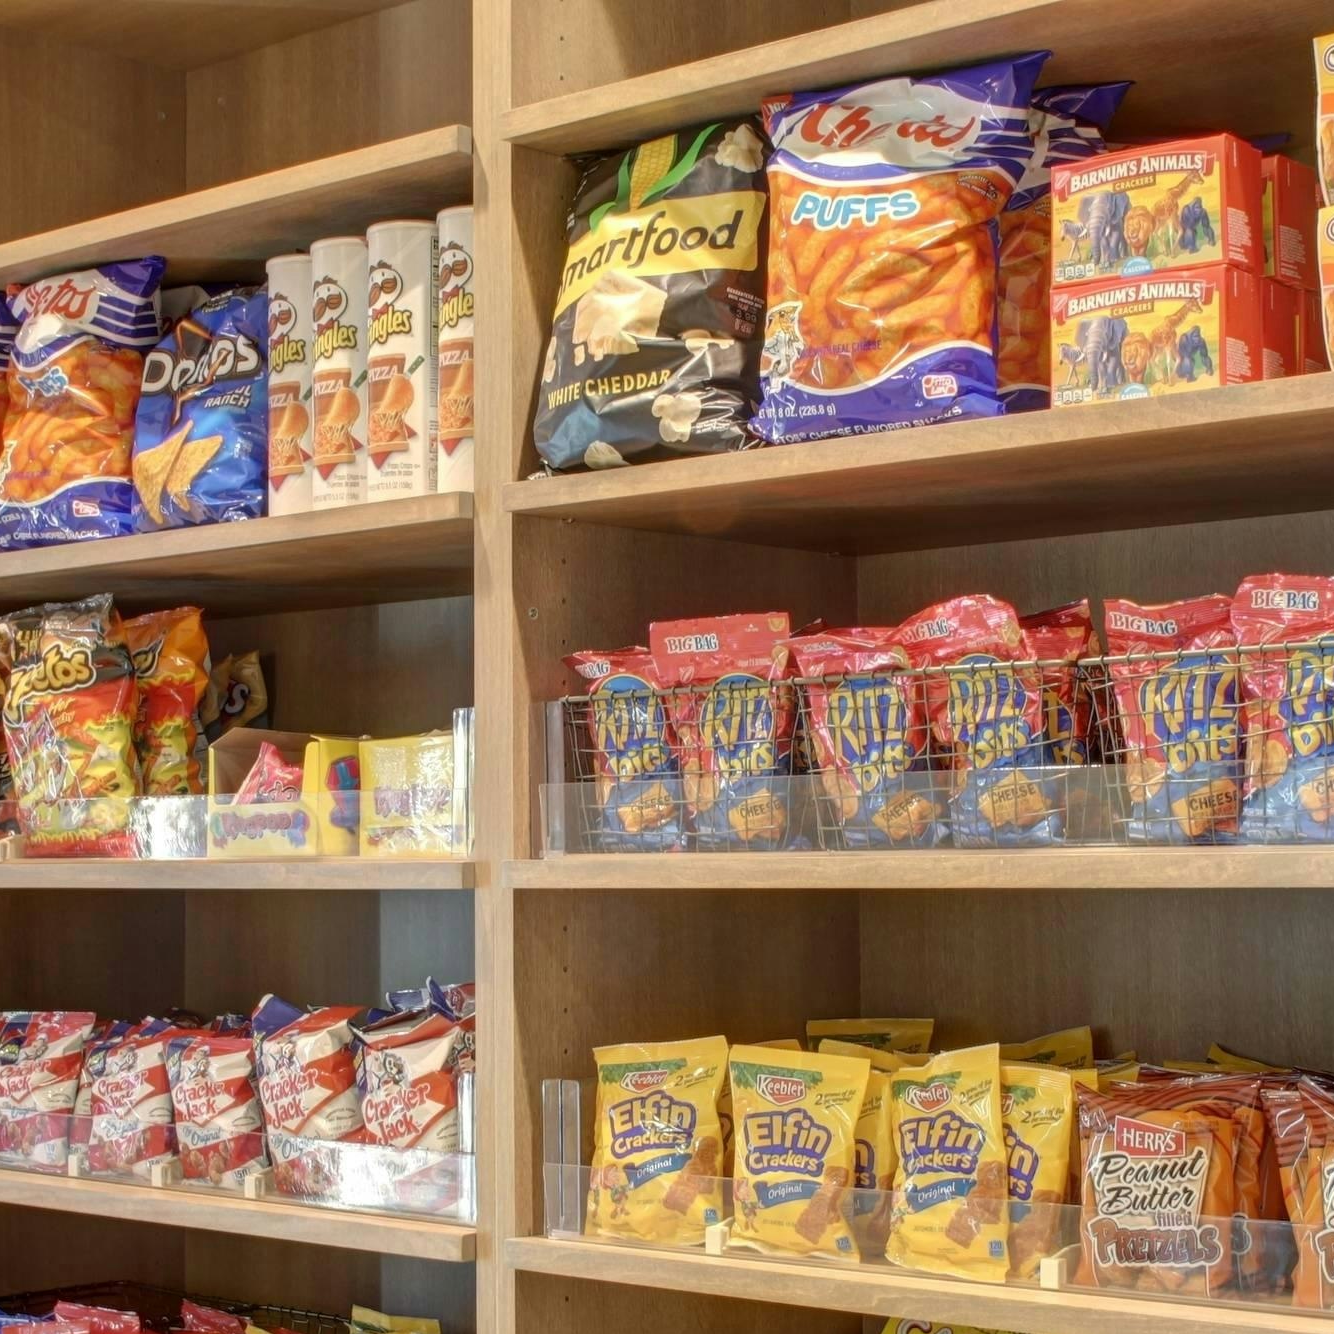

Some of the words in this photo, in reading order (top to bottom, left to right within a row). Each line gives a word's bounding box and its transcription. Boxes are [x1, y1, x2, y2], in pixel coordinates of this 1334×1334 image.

[1070, 157, 1138, 194] BARNUM'S
[1140, 153, 1204, 174] ANIMALS
[1115, 175, 1155, 191] CRACKERS
[792, 191, 921, 231] PUFFS
[1067, 285, 1136, 317] BARNUM'S
[1138, 280, 1202, 302] ANIMALS
[1112, 302, 1152, 317] CRACKERS
[549, 382, 581, 410] WHITE
[585, 369, 671, 397] CHEDDAR
[799, 405, 825, 417] (226.8
[827, 403, 836, 416] g)
[1251, 591, 1284, 608] BIG
[1285, 592, 1318, 610] BAG
[1111, 612, 1143, 631] BIG
[1144, 619, 1176, 635] BAG
[261, 1069, 318, 1103] Cracker
[759, 1075, 804, 1101] Keebler
[268, 1099, 305, 1129] Jack
[613, 1093, 693, 1135] Elfin
[378, 1116, 419, 1144] Jack
[615, 1129, 689, 1154] Crackers
[747, 1112, 831, 1154] Elfin
[1121, 1127, 1176, 1151] HERR'S
[636, 1158, 673, 1177] Original
[749, 1150, 818, 1171] Crackers
[768, 1183, 802, 1200] Original
[918, 1182, 956, 1202] Original
[1091, 1220, 1223, 1266] PRETZELS
